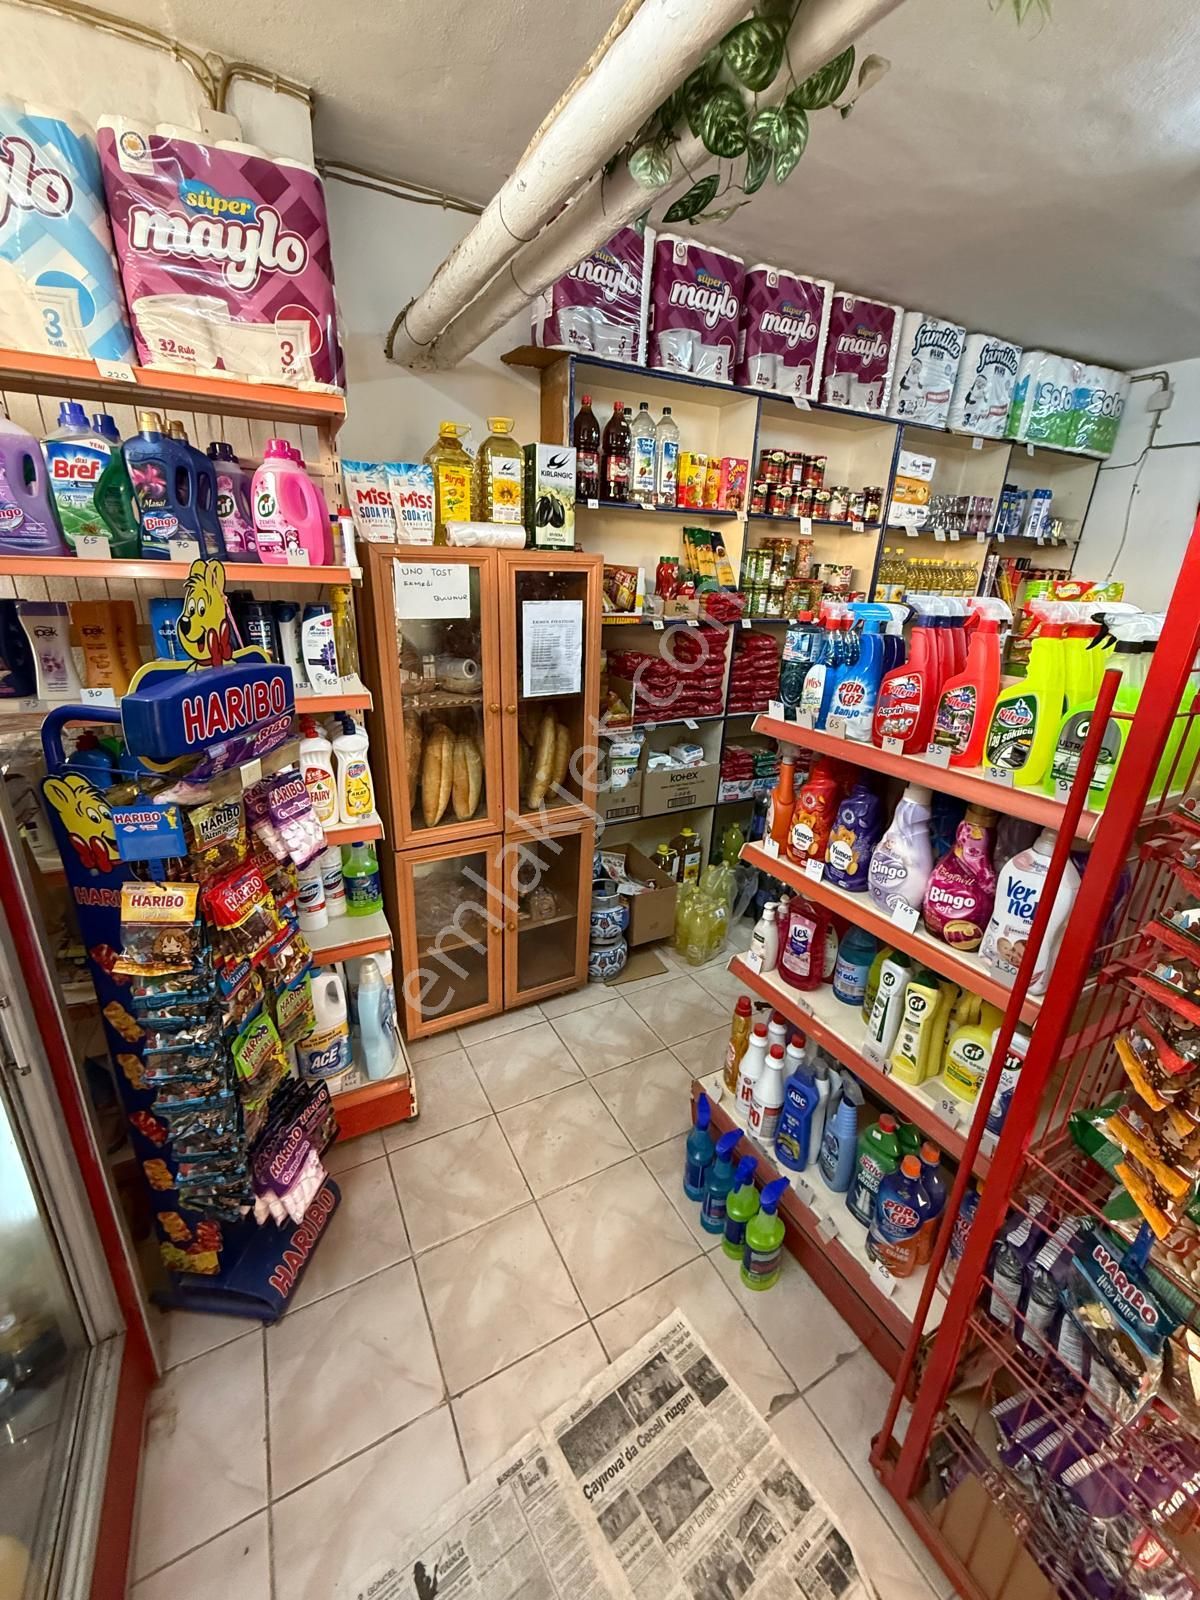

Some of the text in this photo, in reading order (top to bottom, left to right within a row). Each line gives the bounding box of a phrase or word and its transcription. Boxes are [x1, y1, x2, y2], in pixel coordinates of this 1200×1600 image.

[186, 191, 251, 215] süper
[130, 205, 309, 291] maylo
[669, 280, 739, 330] maylo
[42, 308, 63, 338] 3
[760, 310, 818, 349] maylo
[158, 338, 177, 353] 32
[837, 332, 889, 367] maylo
[911, 322, 961, 360] familia
[280, 341, 293, 366] 3
[976, 344, 1018, 376] familia
[1038, 382, 1073, 412] Solo
[1087, 389, 1125, 419] Solo
[53, 459, 100, 479] Bref
[0, 508, 22, 520] ngo
[258, 499, 275, 516] Cif
[144, 516, 178, 531] Bingo
[83, 536, 98, 544] 65
[401, 567, 453, 577] UNO TOST
[838, 683, 862, 693] POR
[182, 676, 287, 745] HARIBO
[878, 705, 905, 717] Asprin
[255, 715, 291, 747] ARIBO
[829, 719, 840, 729] 65
[928, 743, 944, 755] 95
[670, 771, 699, 783] kotex
[990, 768, 1007, 778] 85
[270, 780, 306, 809] HARIBO
[310, 789, 331, 802] FAIRY
[113, 811, 161, 824] HARIBO
[200, 805, 241, 835] HARIBO
[871, 859, 907, 879] Bingo
[73, 886, 122, 908] HARI
[224, 875, 263, 912] HARIBO
[929, 886, 976, 910] Bingo
[1007, 876, 1037, 902] Ver
[131, 895, 185, 908] HARIBO
[935, 902, 953, 915] Soft
[883, 973, 895, 985] Cif
[909, 997, 925, 1011] Cif
[311, 1046, 339, 1069] ACE
[963, 1044, 984, 1061] Cif
[789, 1090, 807, 1107] ABC
[270, 1126, 303, 1179] HARIBO
[884, 1199, 914, 1217] POR
[269, 1185, 337, 1298] HARIBO
[1092, 1244, 1159, 1327] HARIBO
[1112, 1297, 1139, 1324] Potter
[582, 1444, 639, 1503] Çayırova'da
